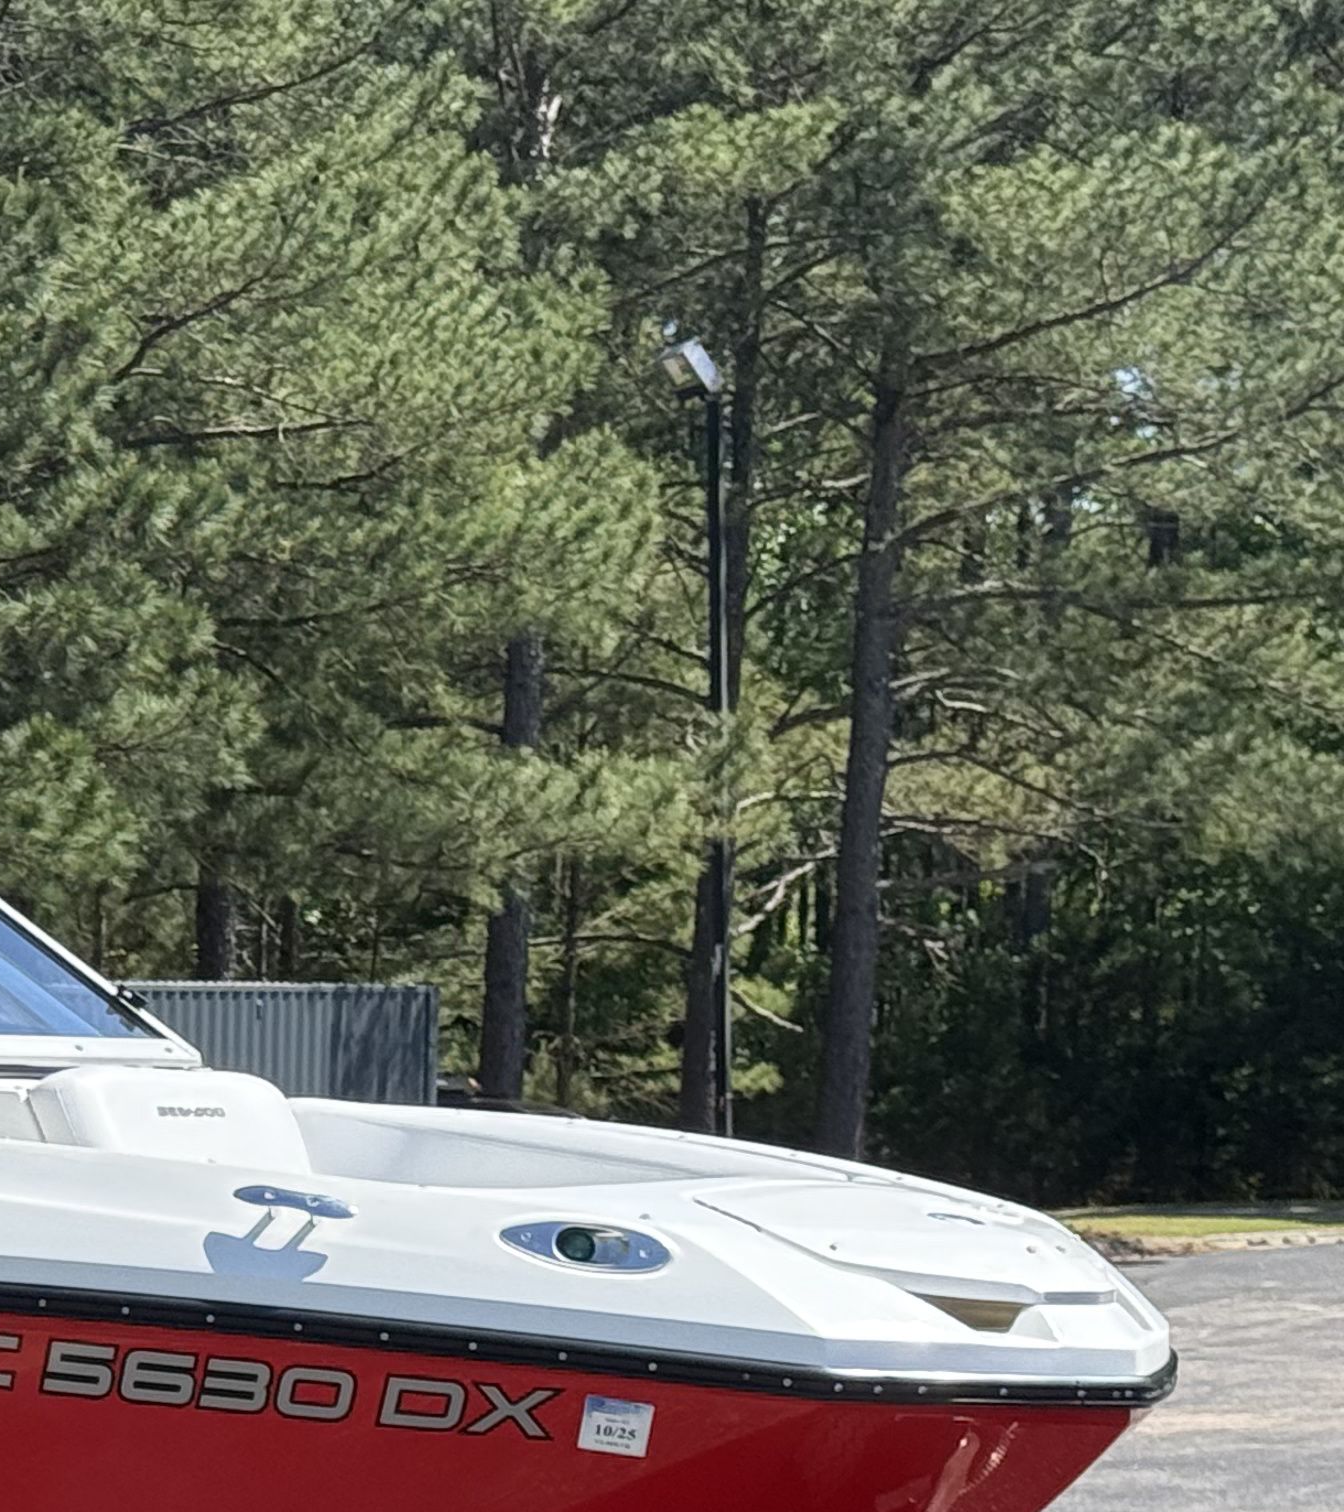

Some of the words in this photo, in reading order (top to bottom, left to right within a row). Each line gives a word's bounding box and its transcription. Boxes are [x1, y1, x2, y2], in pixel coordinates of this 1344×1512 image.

[38, 1337, 359, 1423] 5630
[375, 1373, 566, 1441] DX
[595, 1424, 636, 1440] 10/25
